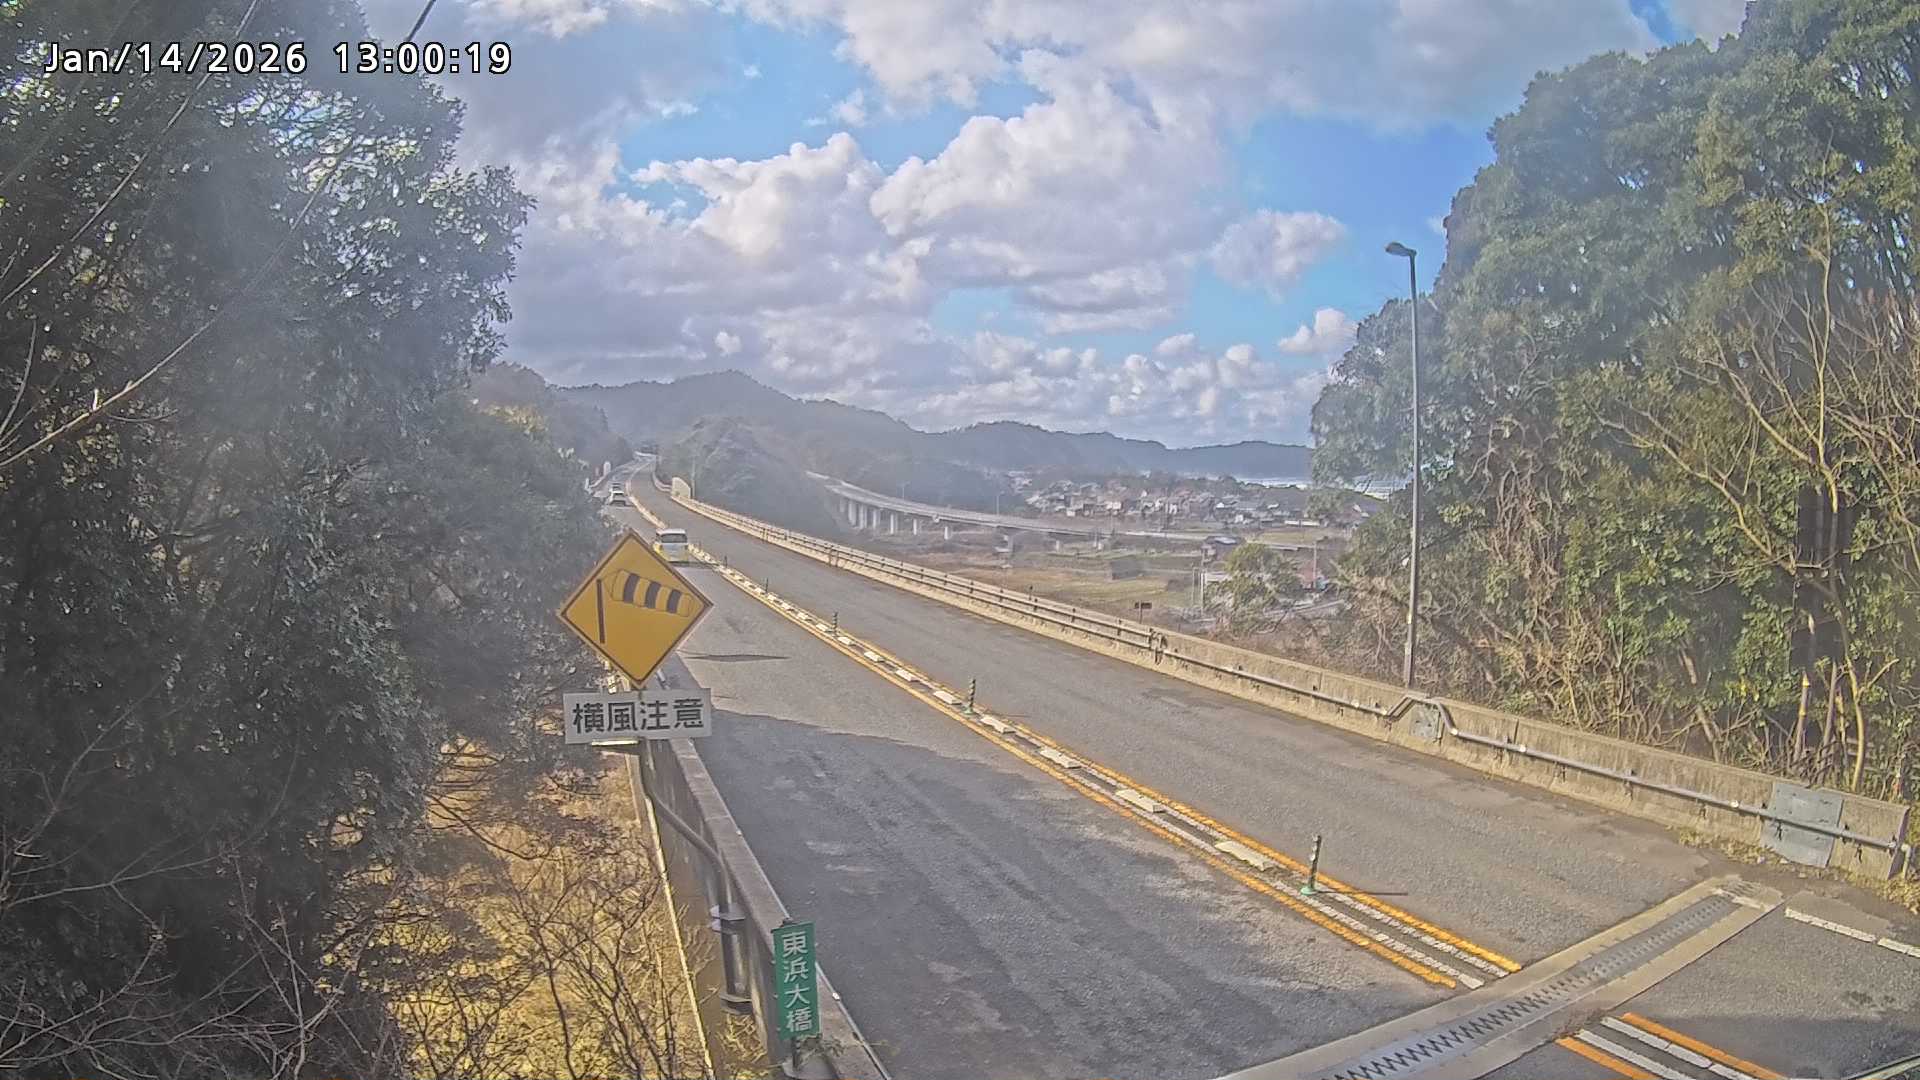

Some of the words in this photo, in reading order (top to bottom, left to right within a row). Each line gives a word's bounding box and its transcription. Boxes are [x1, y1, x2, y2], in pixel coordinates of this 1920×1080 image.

[573, 699, 704, 734] 横風注意
[781, 931, 812, 1032] 東浜大橋
